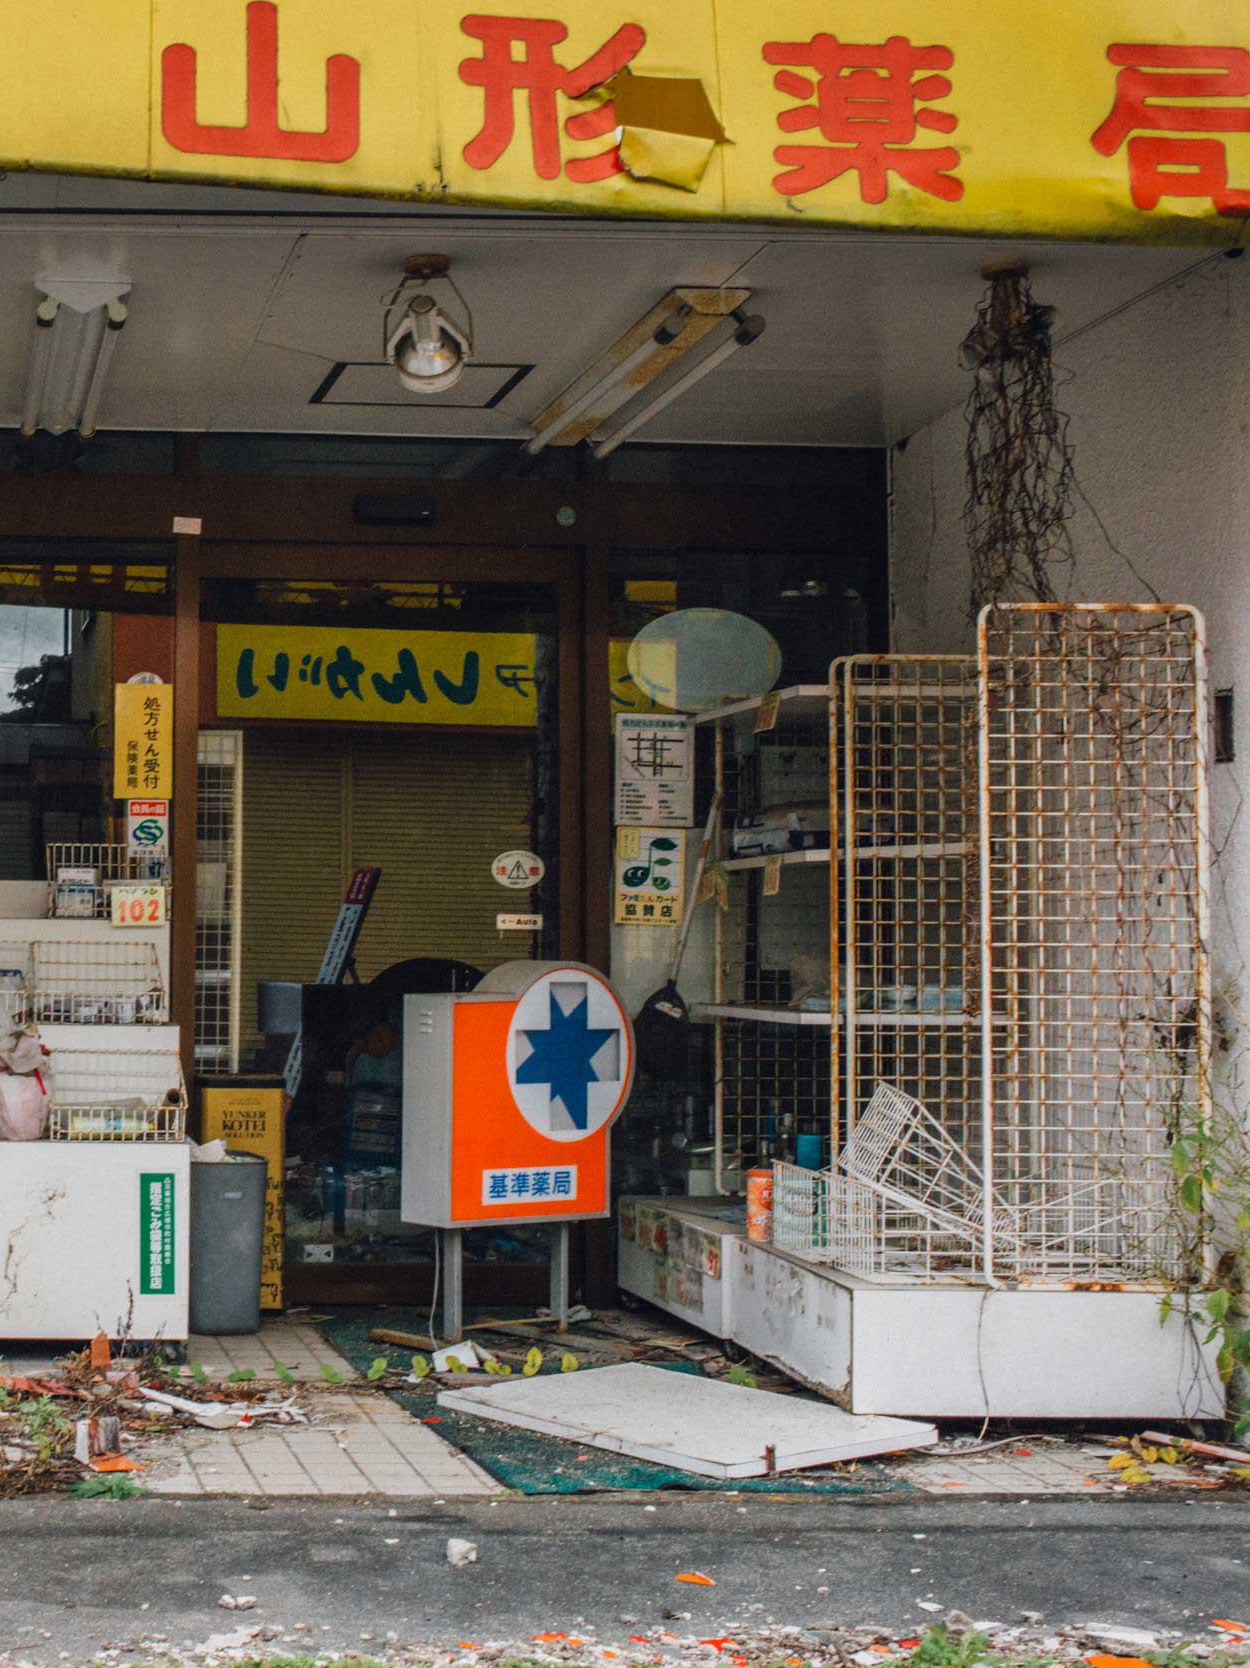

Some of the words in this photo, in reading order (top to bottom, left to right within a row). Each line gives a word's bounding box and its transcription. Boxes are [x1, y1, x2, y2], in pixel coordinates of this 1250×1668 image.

[161, 0, 1250, 217] 山形薬局
[143, 696, 162, 789] 処方せん受付
[126, 740, 139, 788] 保険薬局
[117, 898, 159, 922] 102
[625, 903, 673, 918] 協賛店
[488, 1170, 572, 1199] 基準薬局
